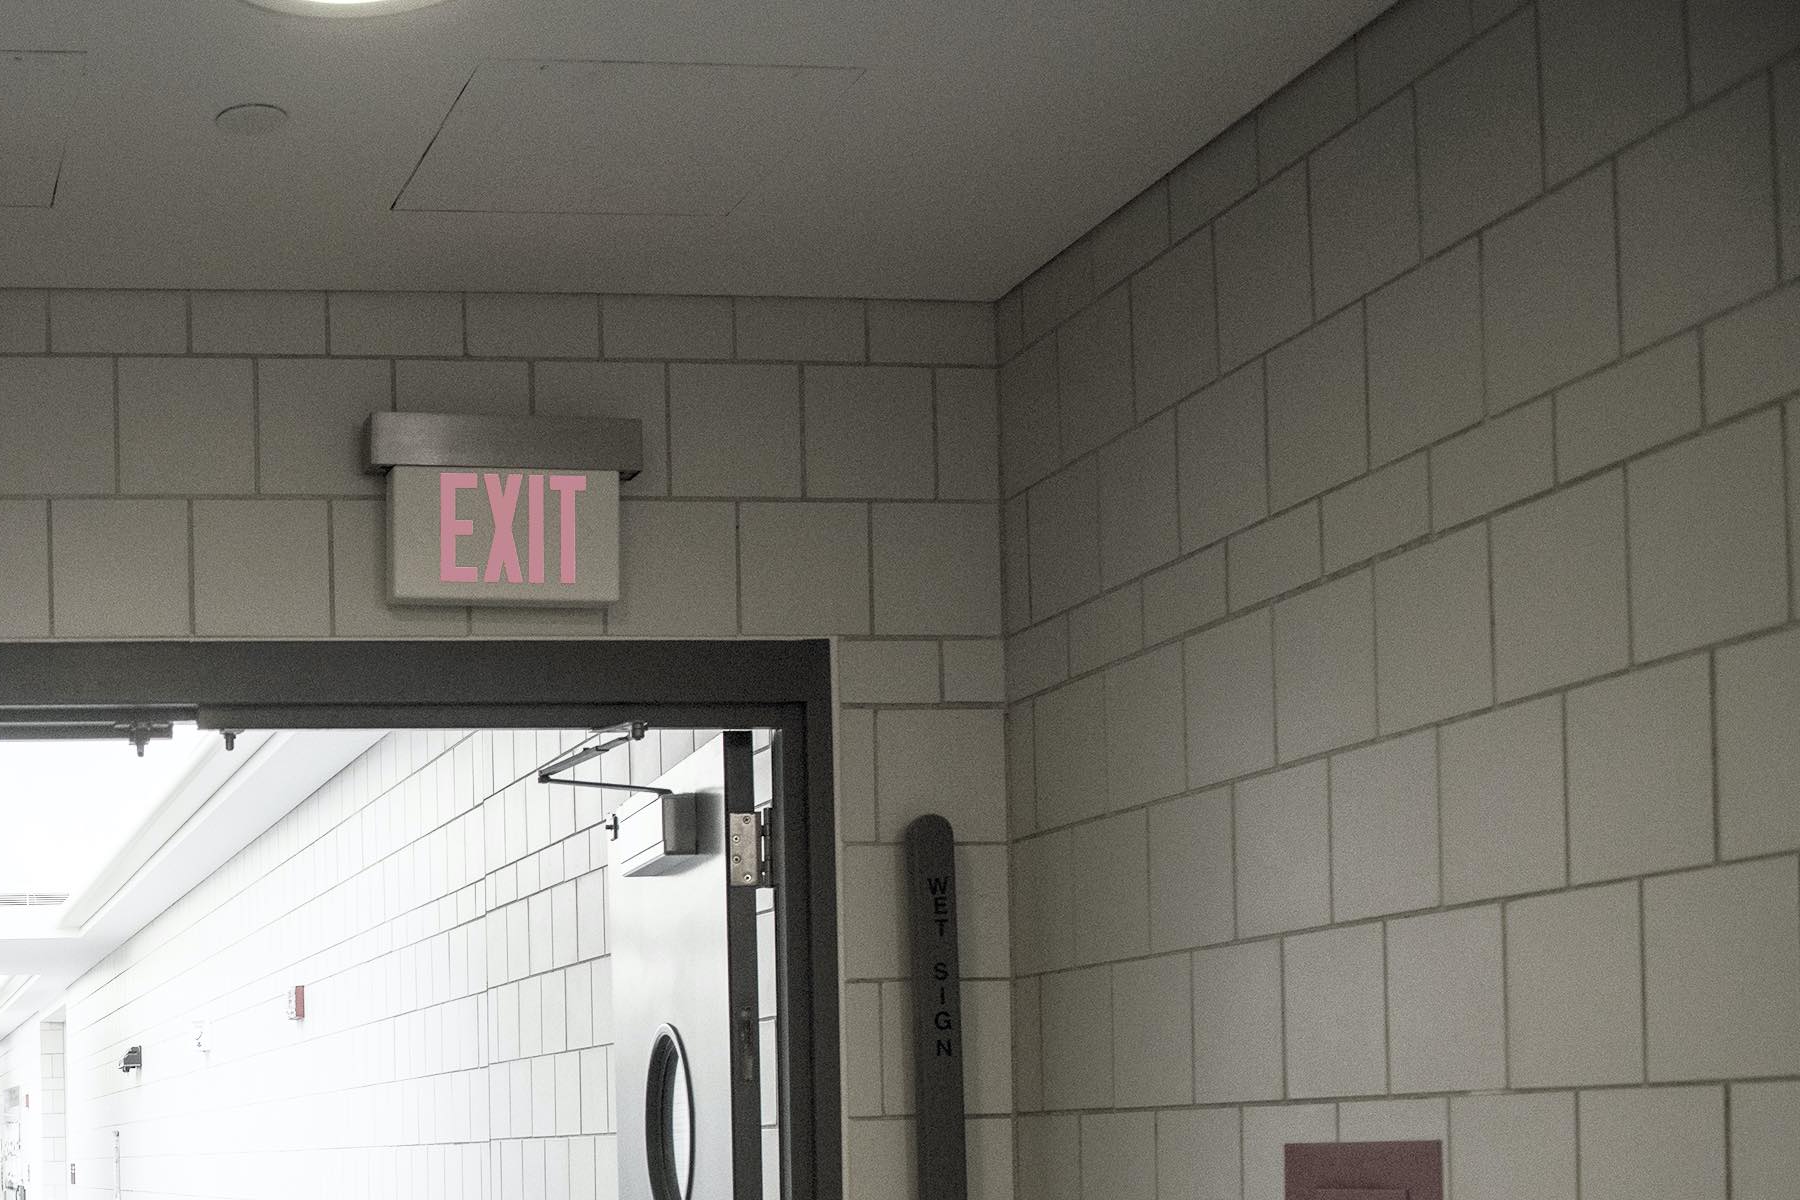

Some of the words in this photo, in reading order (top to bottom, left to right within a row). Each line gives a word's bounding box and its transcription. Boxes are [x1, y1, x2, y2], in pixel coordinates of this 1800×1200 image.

[439, 472, 587, 585] EXIT
[927, 877, 949, 937] WET
[933, 962, 952, 1057] SIGN
